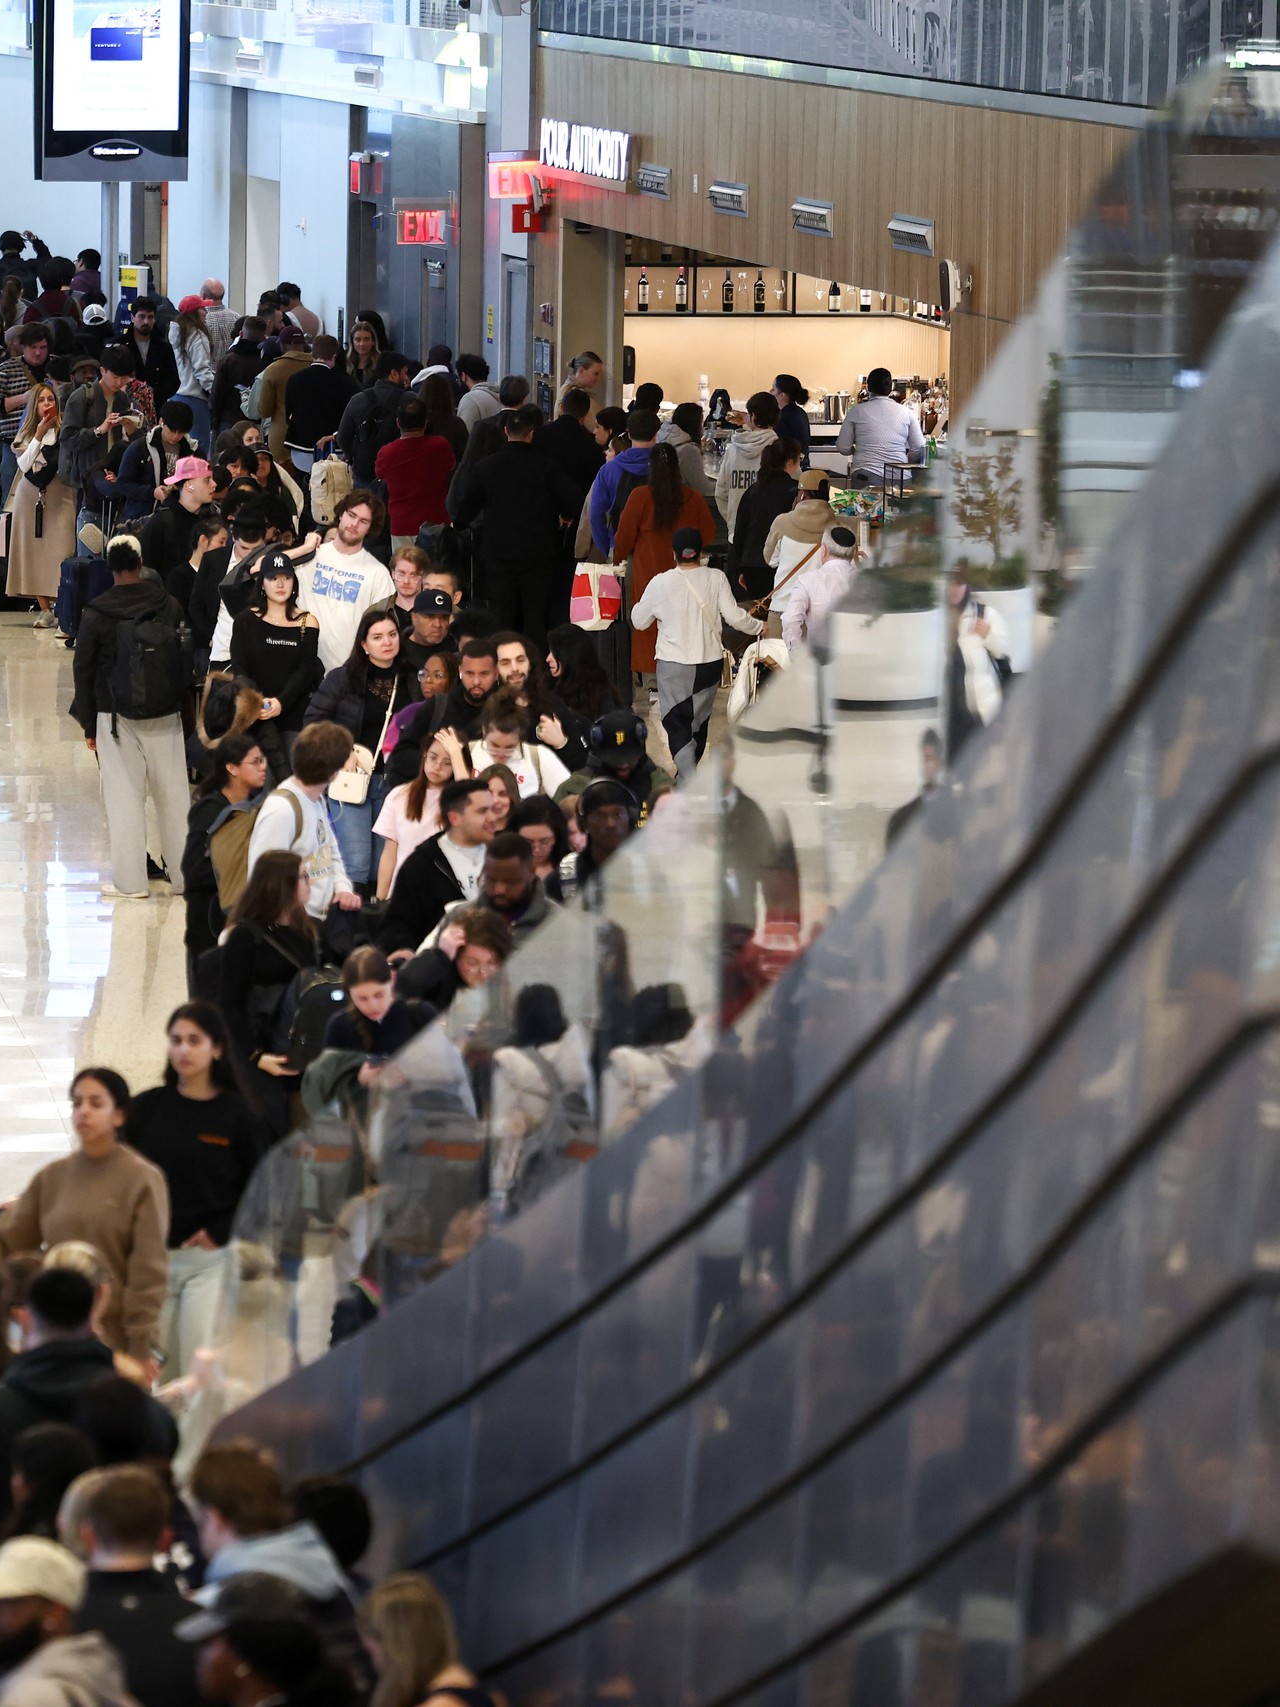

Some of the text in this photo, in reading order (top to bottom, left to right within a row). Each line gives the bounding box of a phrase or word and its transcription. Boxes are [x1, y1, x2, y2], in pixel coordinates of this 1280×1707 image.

[540, 118, 629, 181] POUR AUTHORITY
[404, 211, 442, 241] EXIT
[273, 556, 284, 568] NY
[315, 562, 366, 581] DEFTONES
[435, 595, 444, 605] C
[266, 637, 297, 647] threetimes
